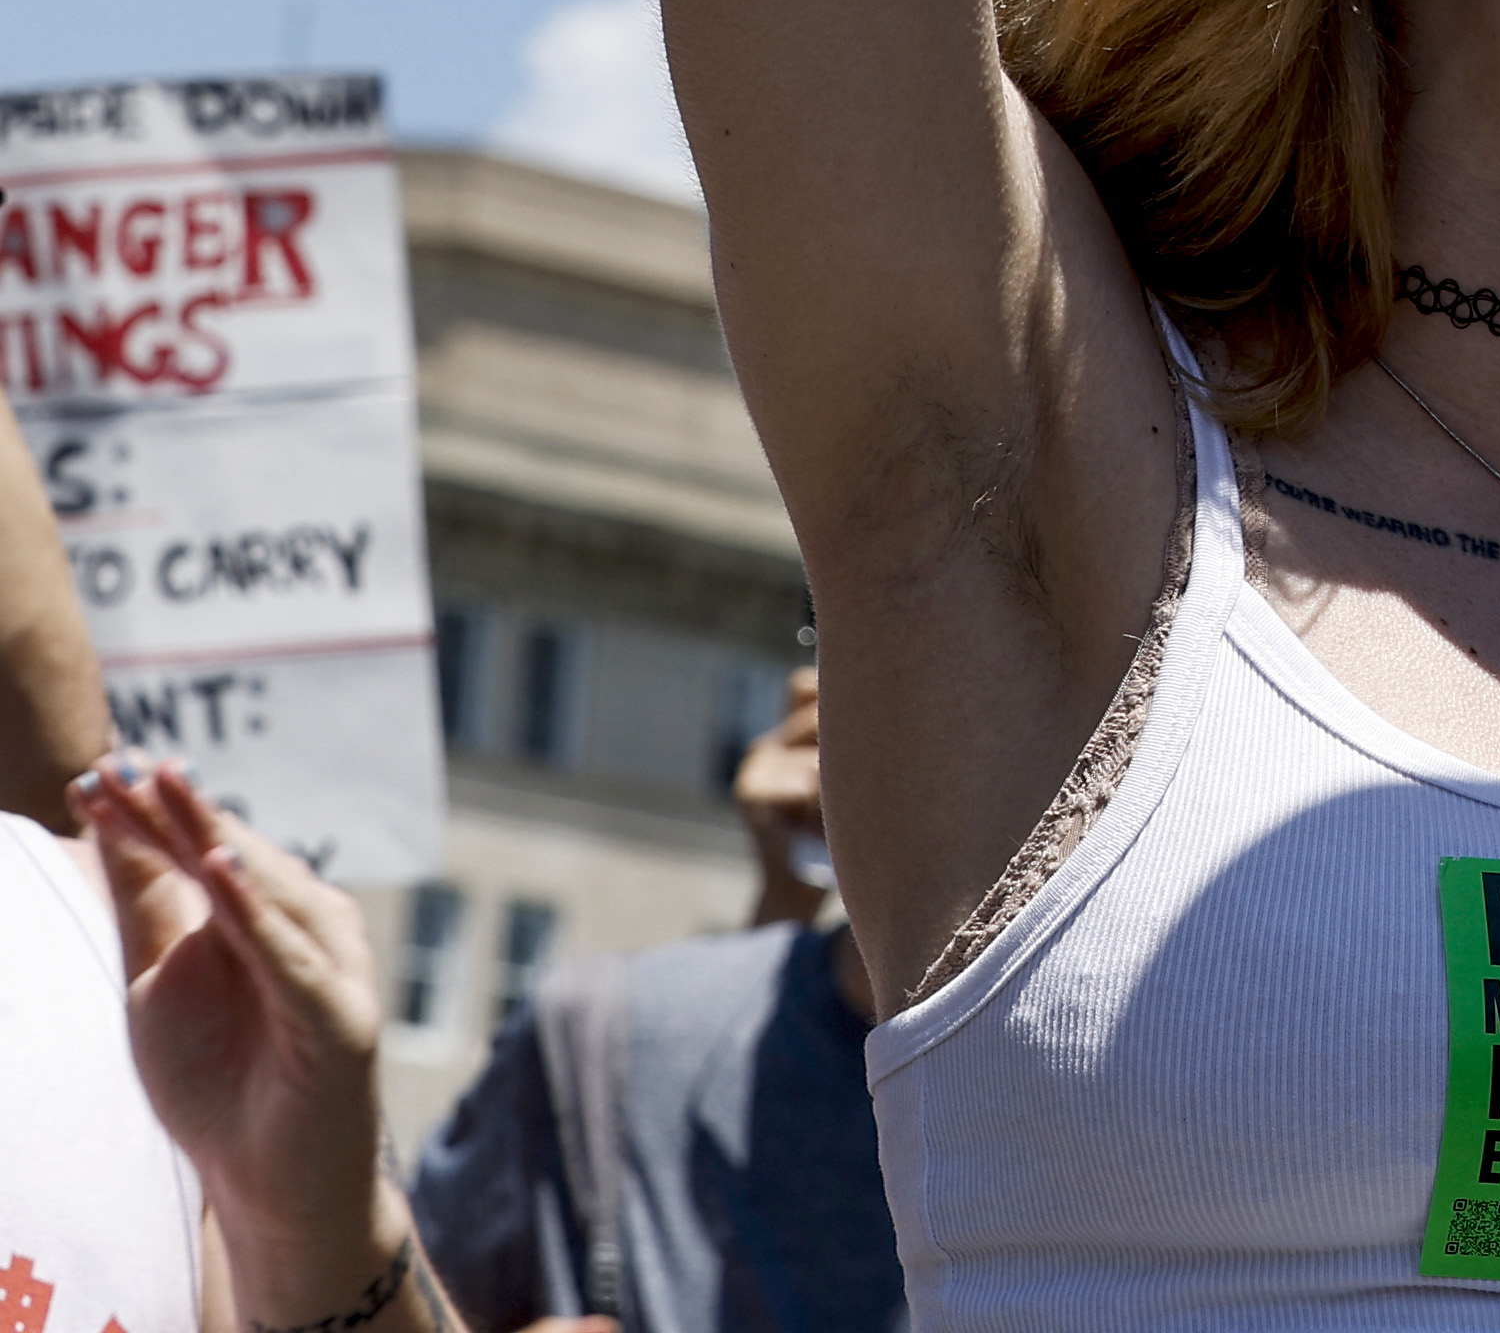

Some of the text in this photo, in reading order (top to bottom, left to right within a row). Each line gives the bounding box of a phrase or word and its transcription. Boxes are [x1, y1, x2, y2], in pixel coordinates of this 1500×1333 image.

[0, 289, 230, 393] INGS
[1341, 505, 1451, 547] WEARING
[1456, 532, 1500, 561] THE
[66, 545, 131, 606] O
